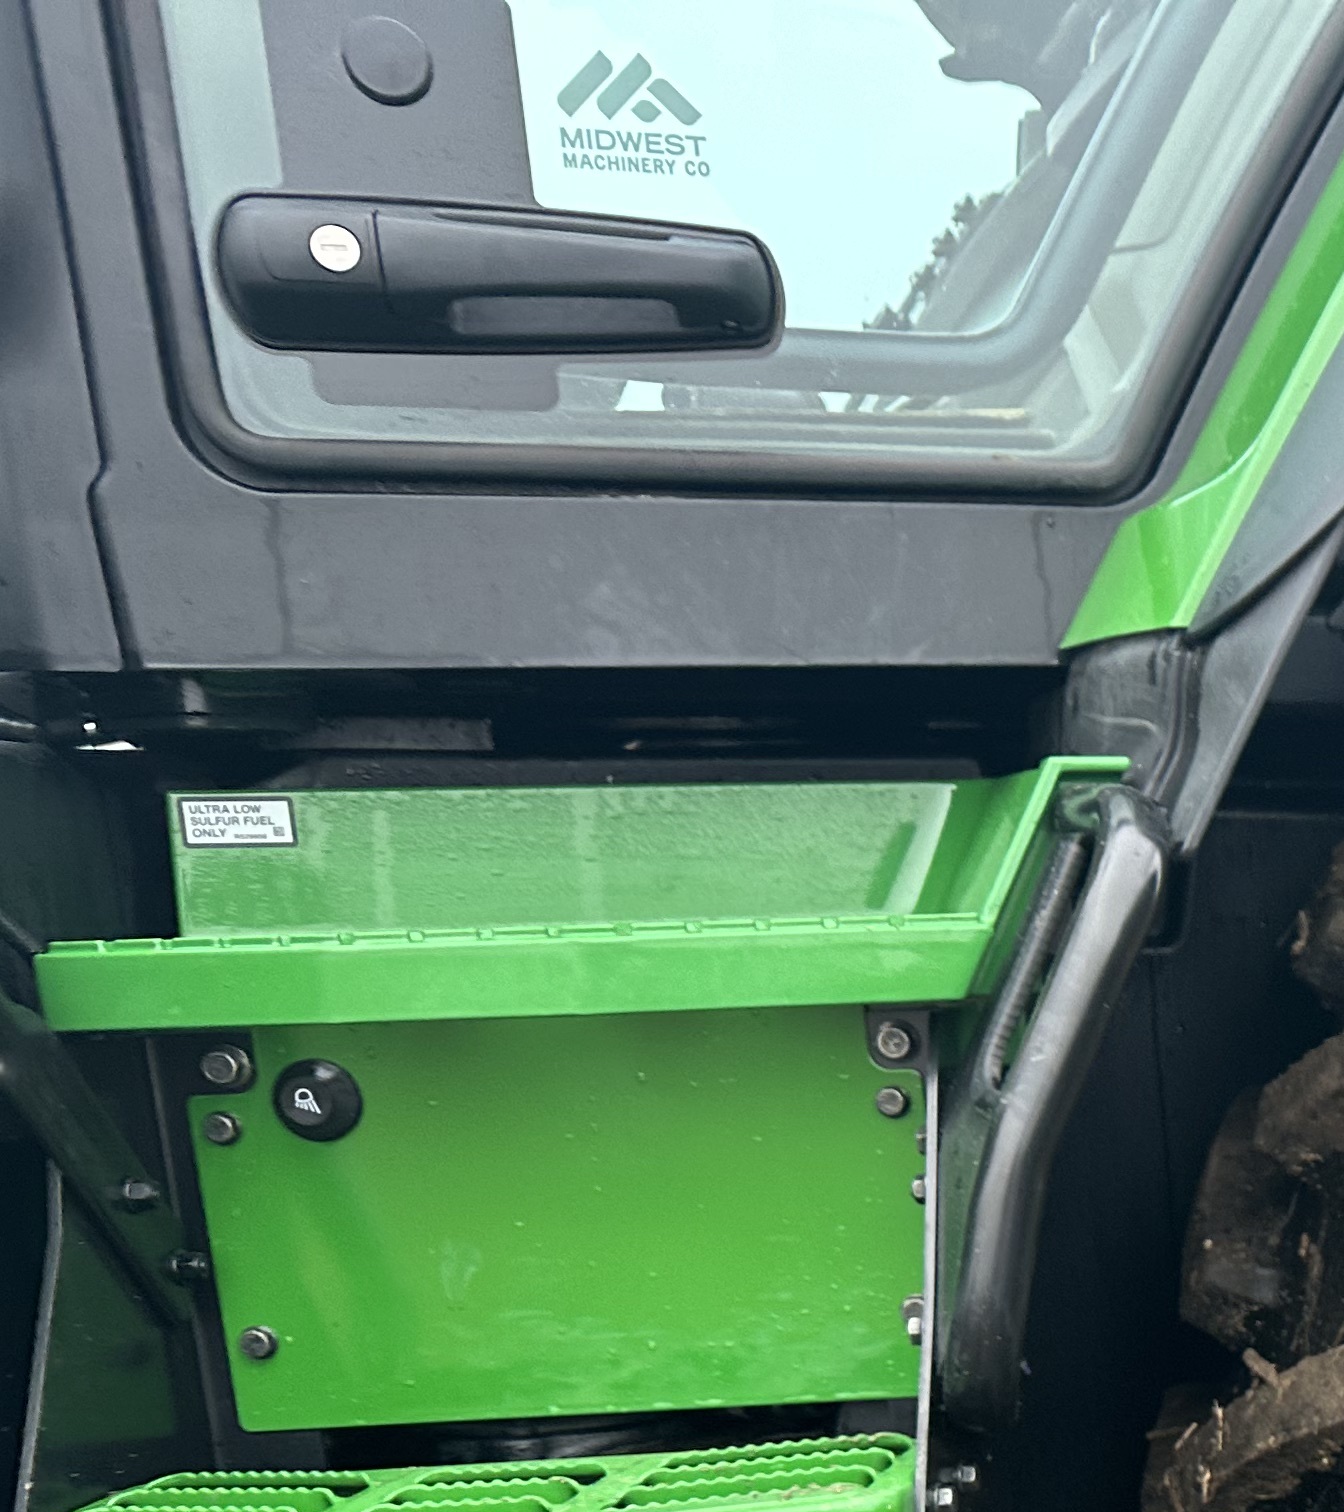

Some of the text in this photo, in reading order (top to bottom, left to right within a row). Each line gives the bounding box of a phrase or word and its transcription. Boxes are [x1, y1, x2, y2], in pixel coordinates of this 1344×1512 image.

[560, 127, 706, 156] MIDWEST
[563, 153, 710, 176] MACHINERY CO
[189, 805, 261, 814] ULTRA LOW
[191, 817, 275, 826] SULFUR FUEL
[193, 829, 227, 838] ONLY
